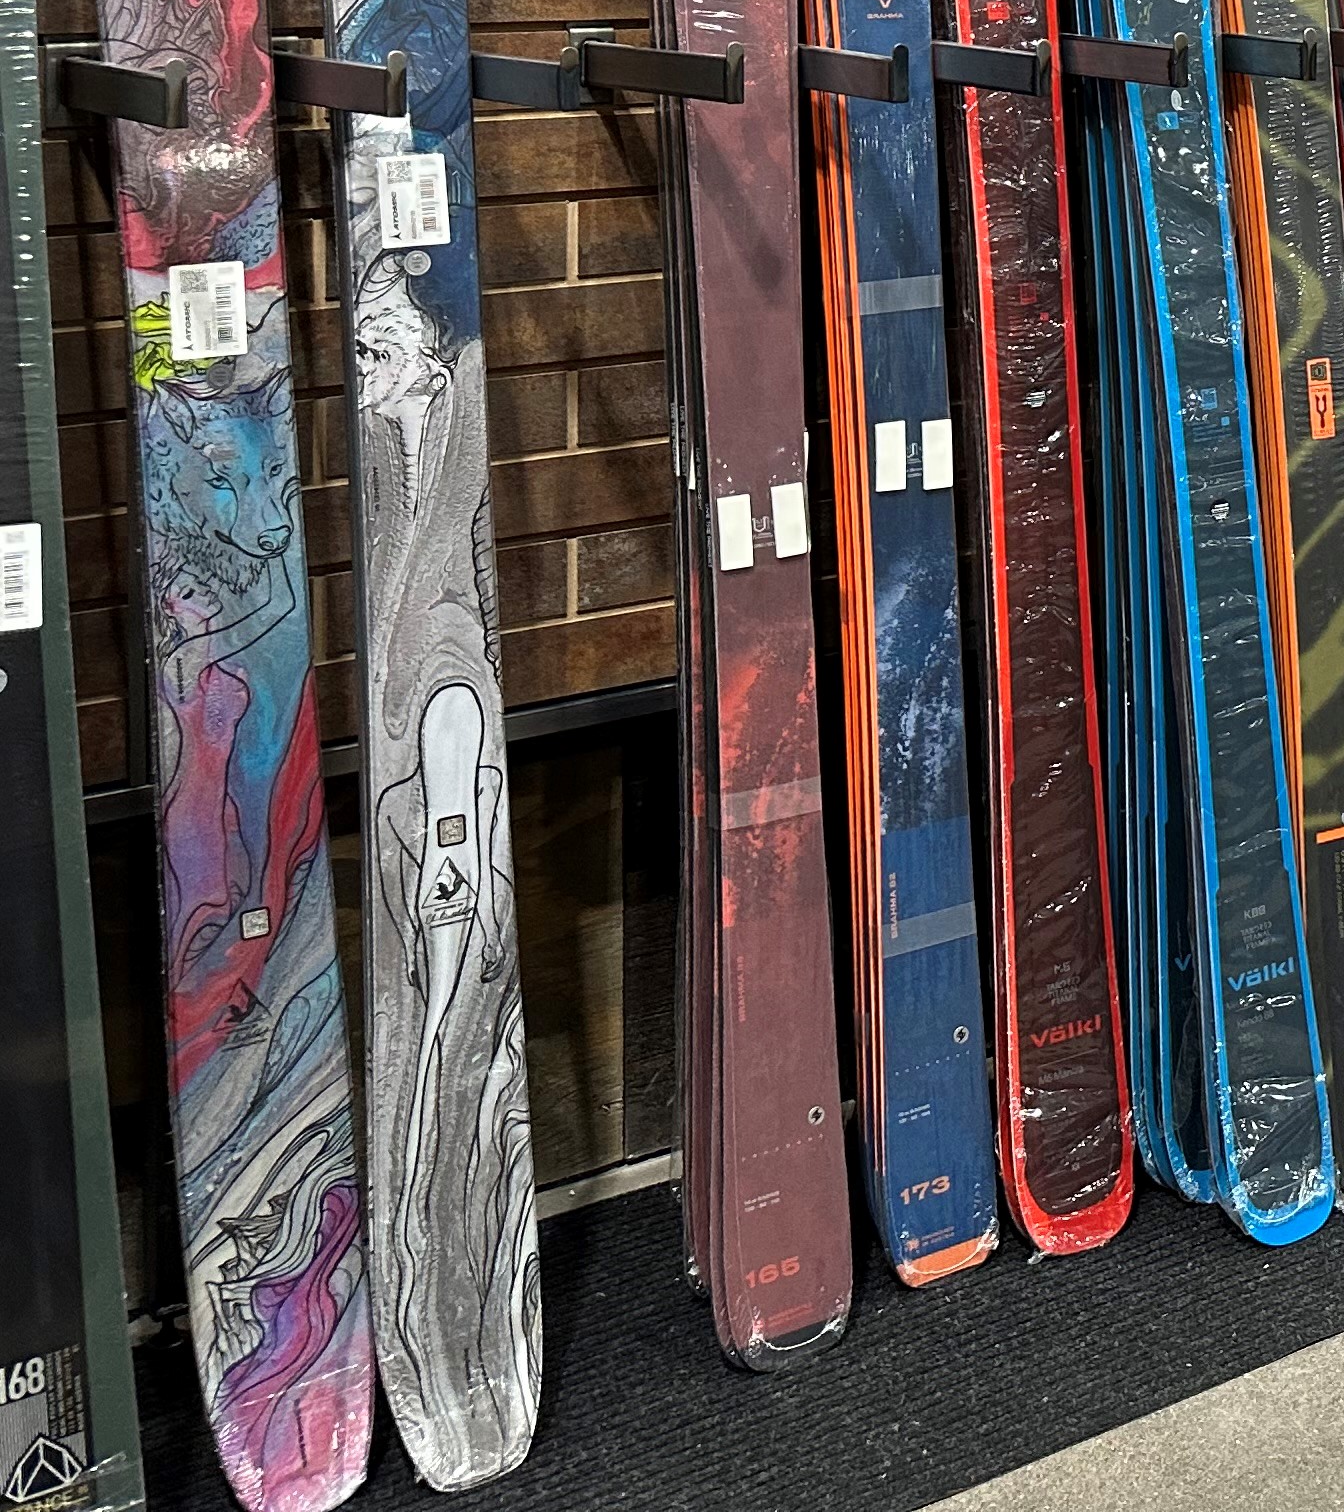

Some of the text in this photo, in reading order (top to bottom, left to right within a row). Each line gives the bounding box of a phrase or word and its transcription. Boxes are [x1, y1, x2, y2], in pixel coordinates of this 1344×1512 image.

[889, 892, 900, 939] BRAHMA
[1227, 956, 1295, 992] Völkl
[1029, 1014, 1103, 1049] Völkl
[898, 1173, 952, 1207] 173
[744, 1254, 802, 1290] 165
